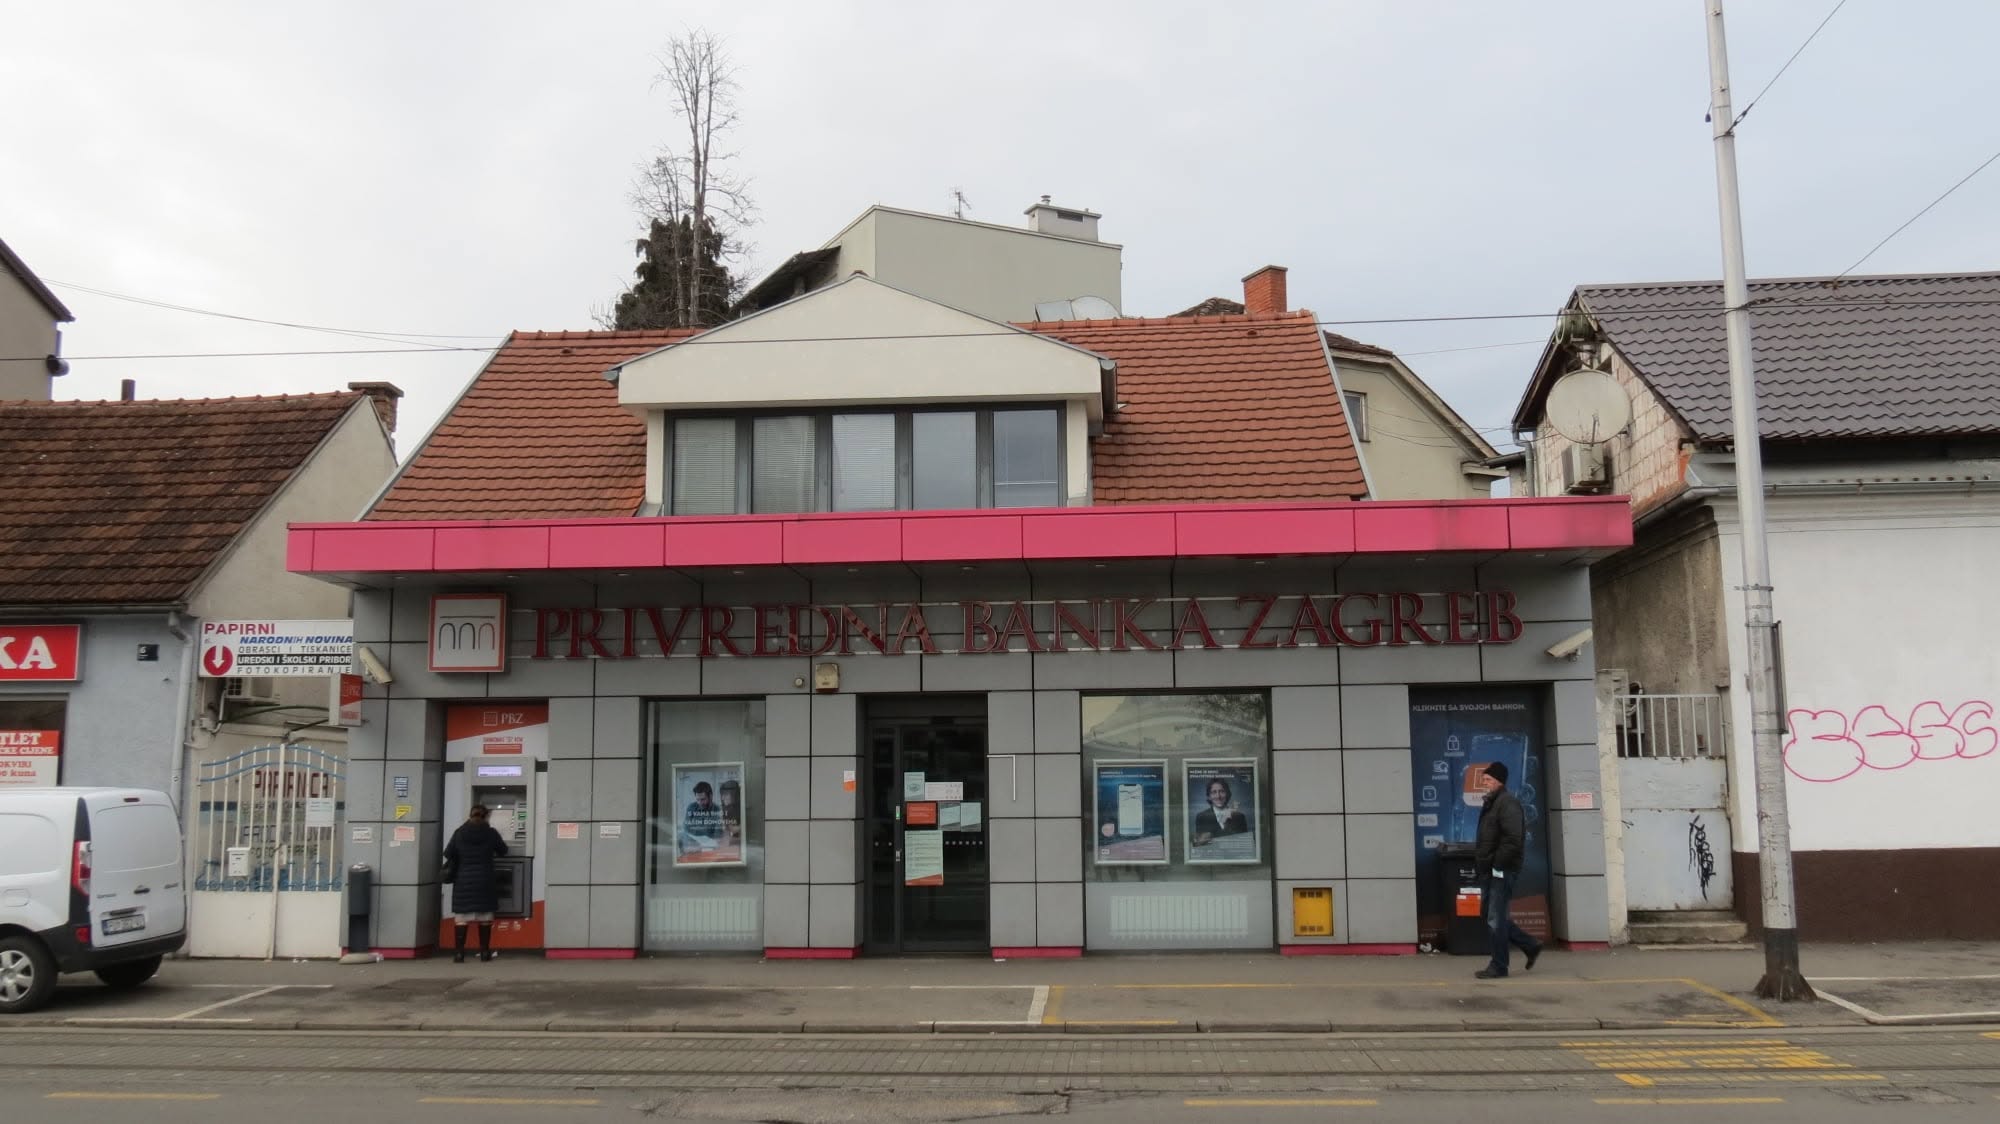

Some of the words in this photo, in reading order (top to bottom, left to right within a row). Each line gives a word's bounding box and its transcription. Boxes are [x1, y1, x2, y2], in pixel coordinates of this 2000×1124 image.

[531, 602, 942, 659] PRIVREDNA
[959, 597, 1222, 653] BANKA
[1235, 590, 1524, 649] ZAGREB
[305, 635, 353, 644] NOVINA
[238, 645, 280, 654] OBRASCI
[301, 645, 352, 653] TISKANICE
[238, 655, 274, 664] UREDSKI
[281, 653, 316, 664] ŠKOLSKI
[319, 655, 351, 664] PRIBOR
[237, 666, 352, 674] FOTOKOPIRANJE
[1448, 703, 1458, 711] SA
[501, 712, 524, 724] PBZ
